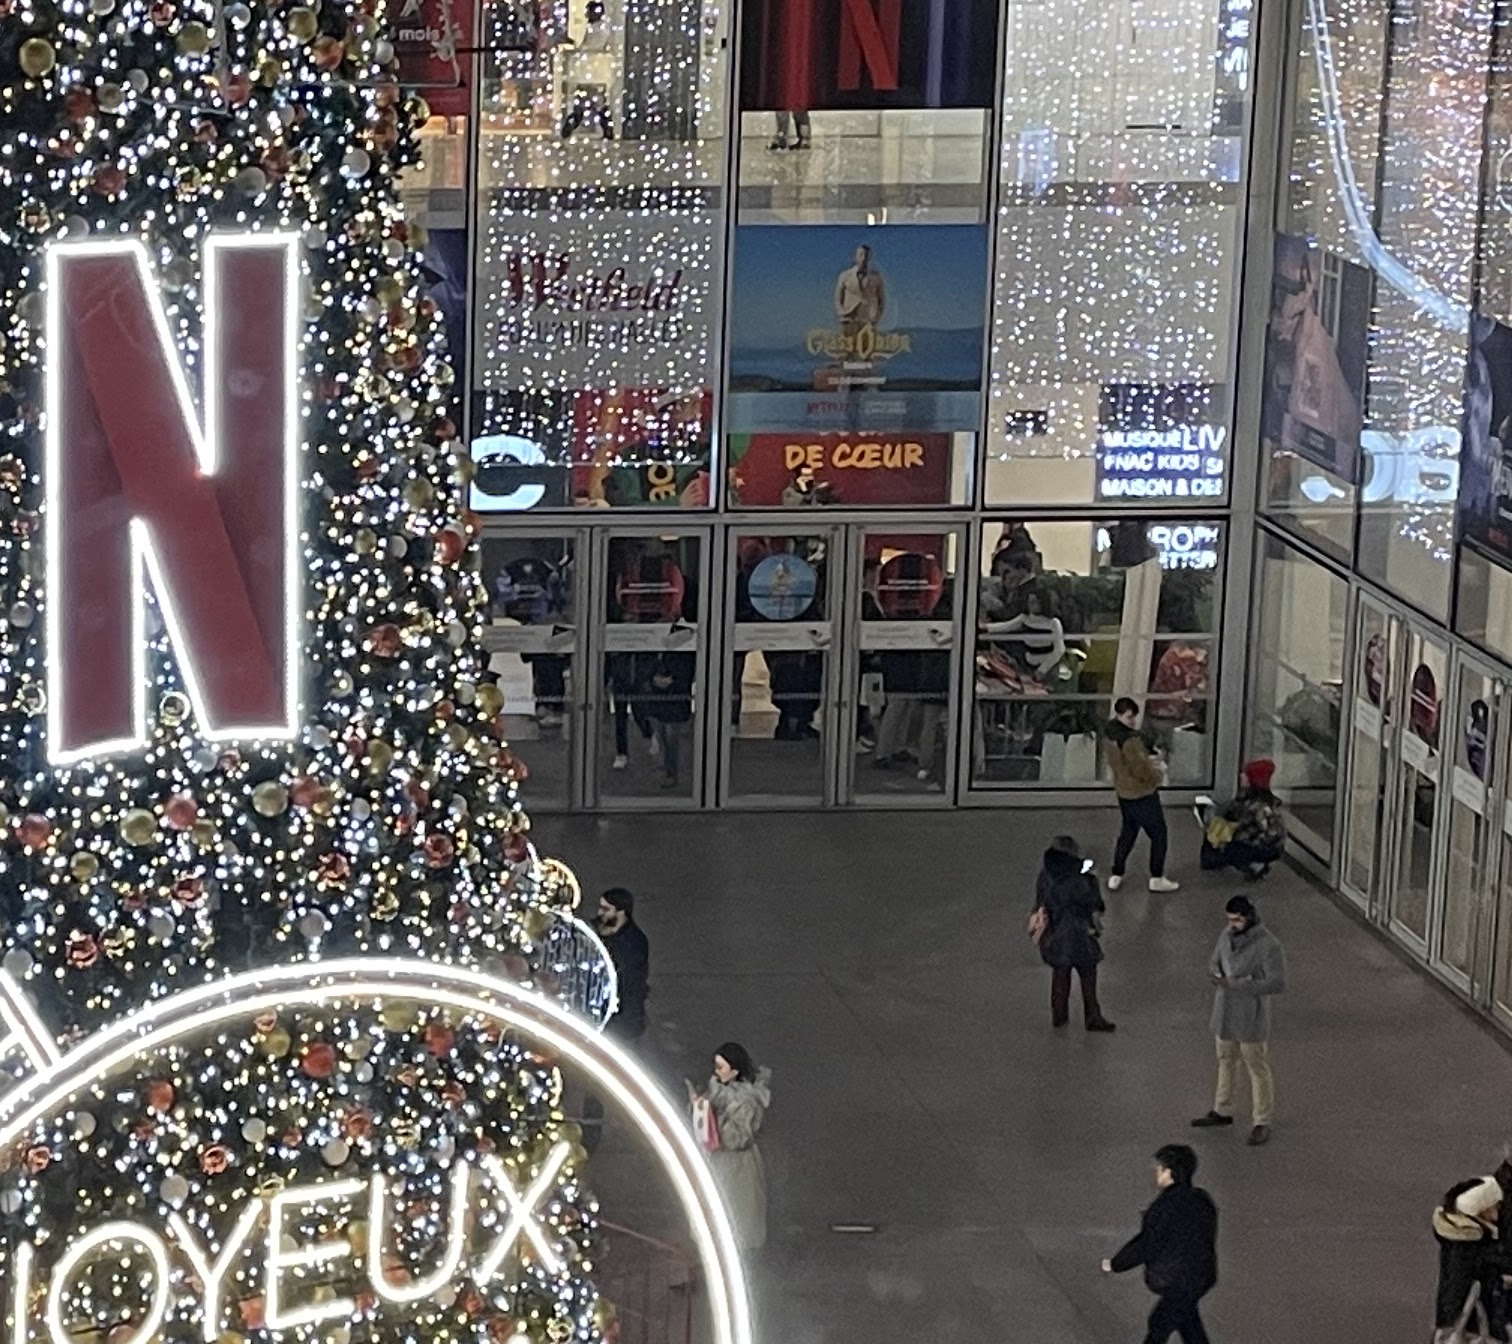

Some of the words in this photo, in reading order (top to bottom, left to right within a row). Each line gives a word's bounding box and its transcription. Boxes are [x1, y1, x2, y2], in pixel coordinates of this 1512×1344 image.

[785, 444, 825, 470] DE
[832, 443, 925, 469] CŒUR
[1104, 452, 1155, 472] FNAC
[1157, 453, 1200, 471] KIDS
[46, 231, 301, 764] N
[1101, 478, 1173, 496] MAISON
